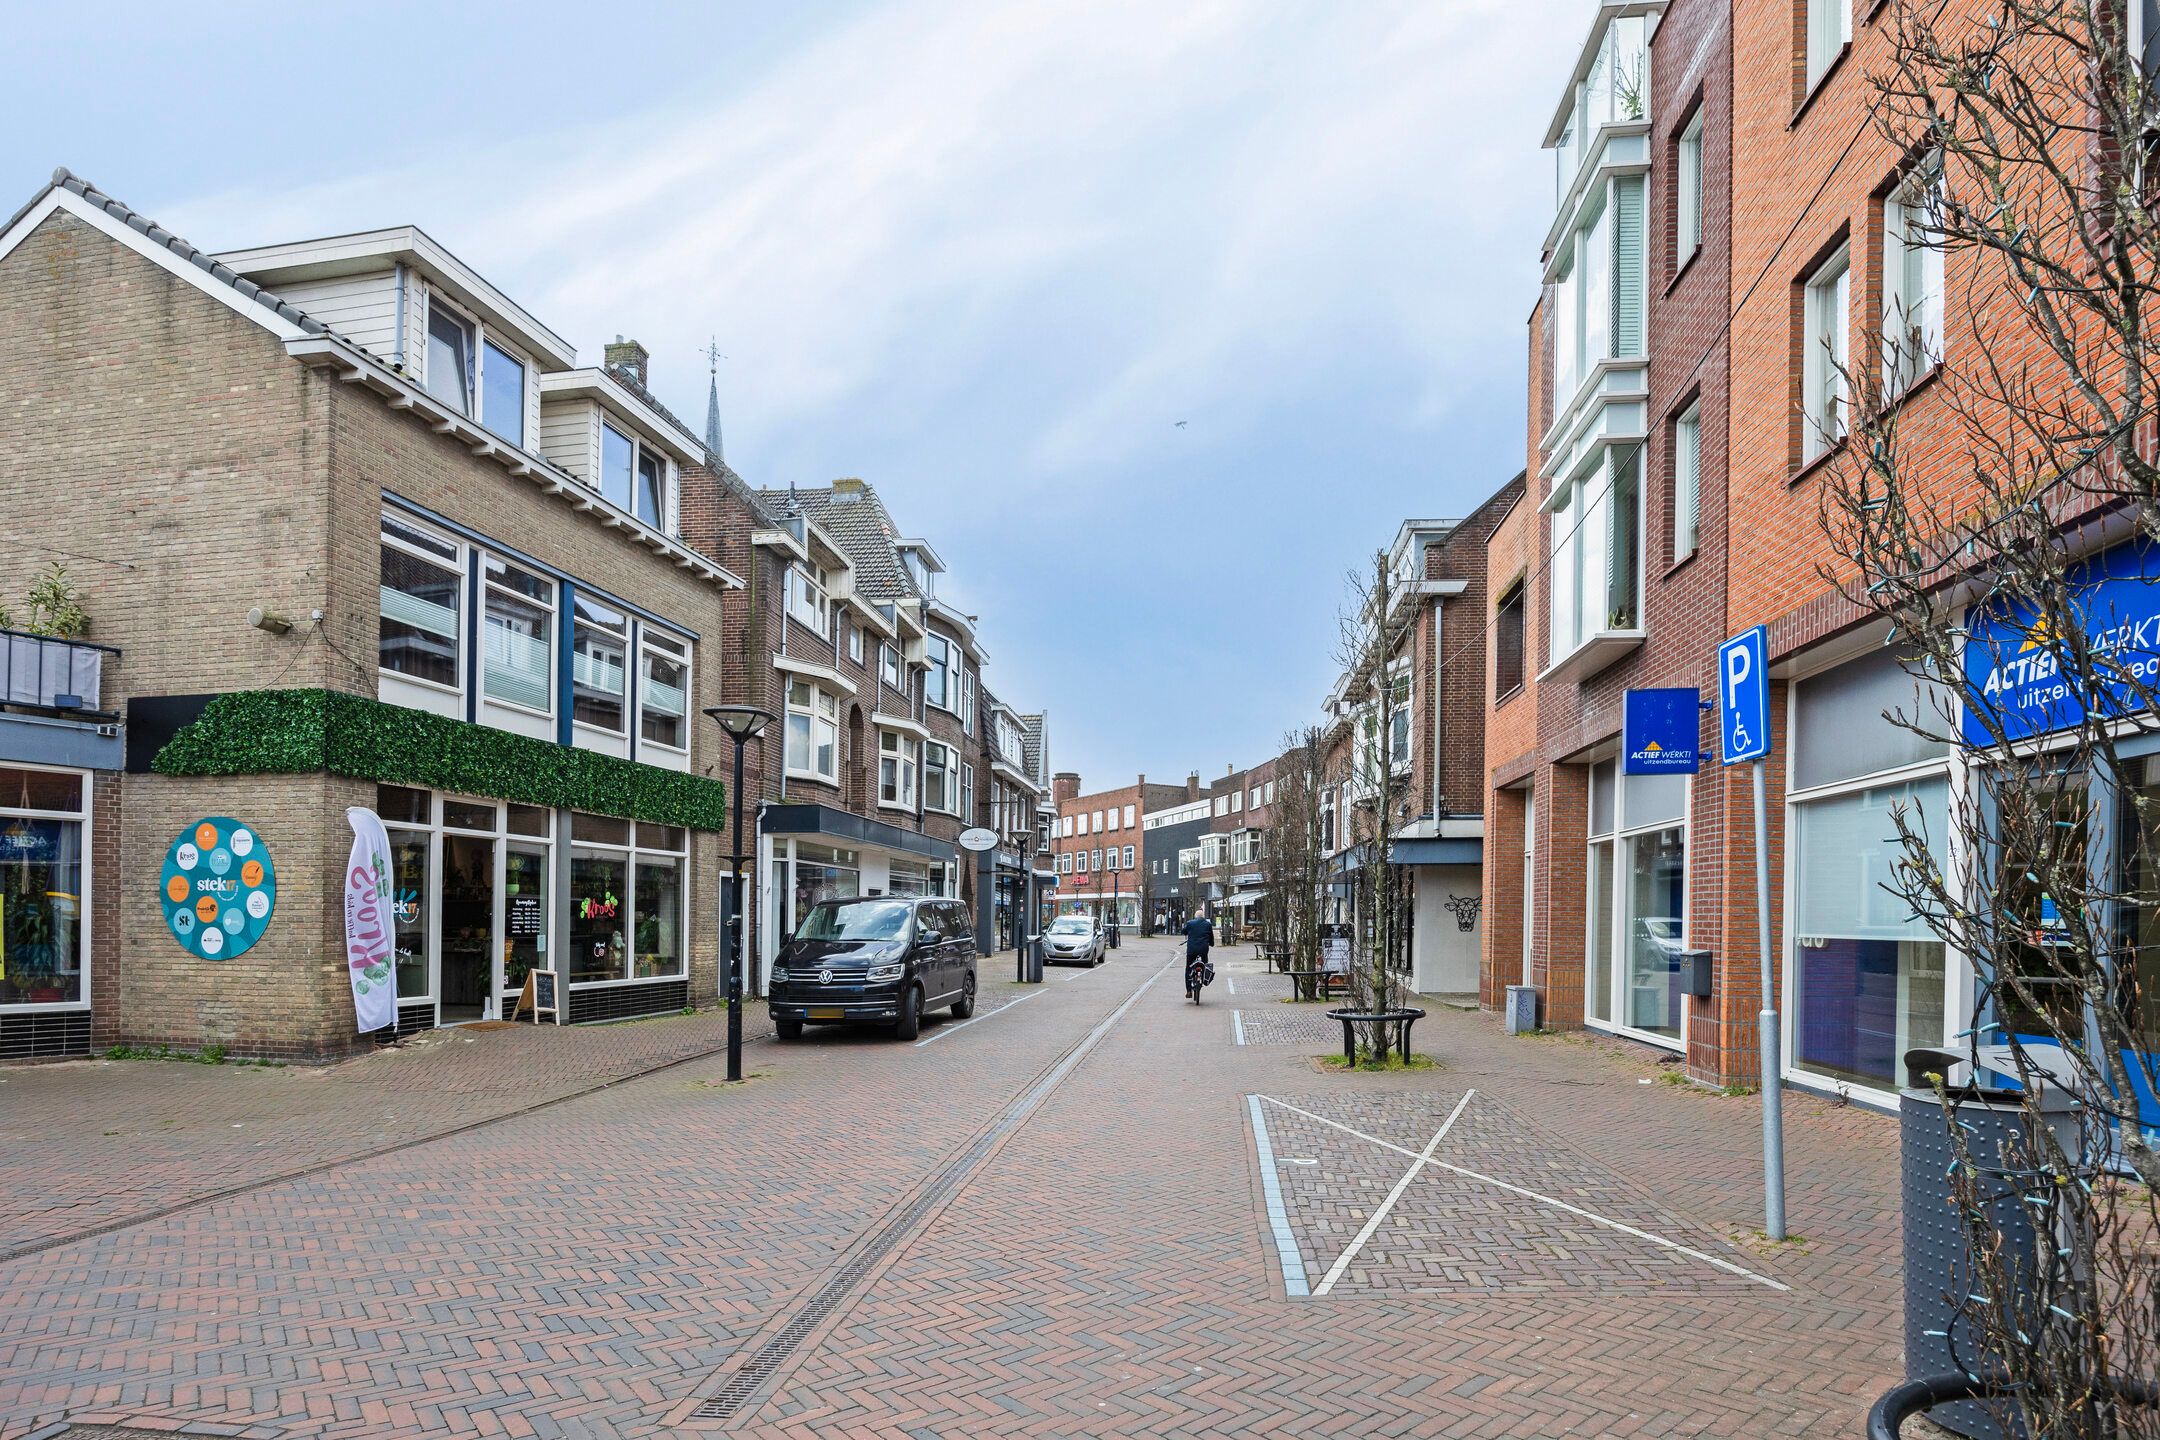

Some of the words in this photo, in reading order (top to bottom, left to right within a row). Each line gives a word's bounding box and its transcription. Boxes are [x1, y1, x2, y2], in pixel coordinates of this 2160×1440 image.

[1727, 644, 1751, 710] P
[1631, 751, 1661, 759] ACTIEF
[197, 877, 237, 891] stek17
